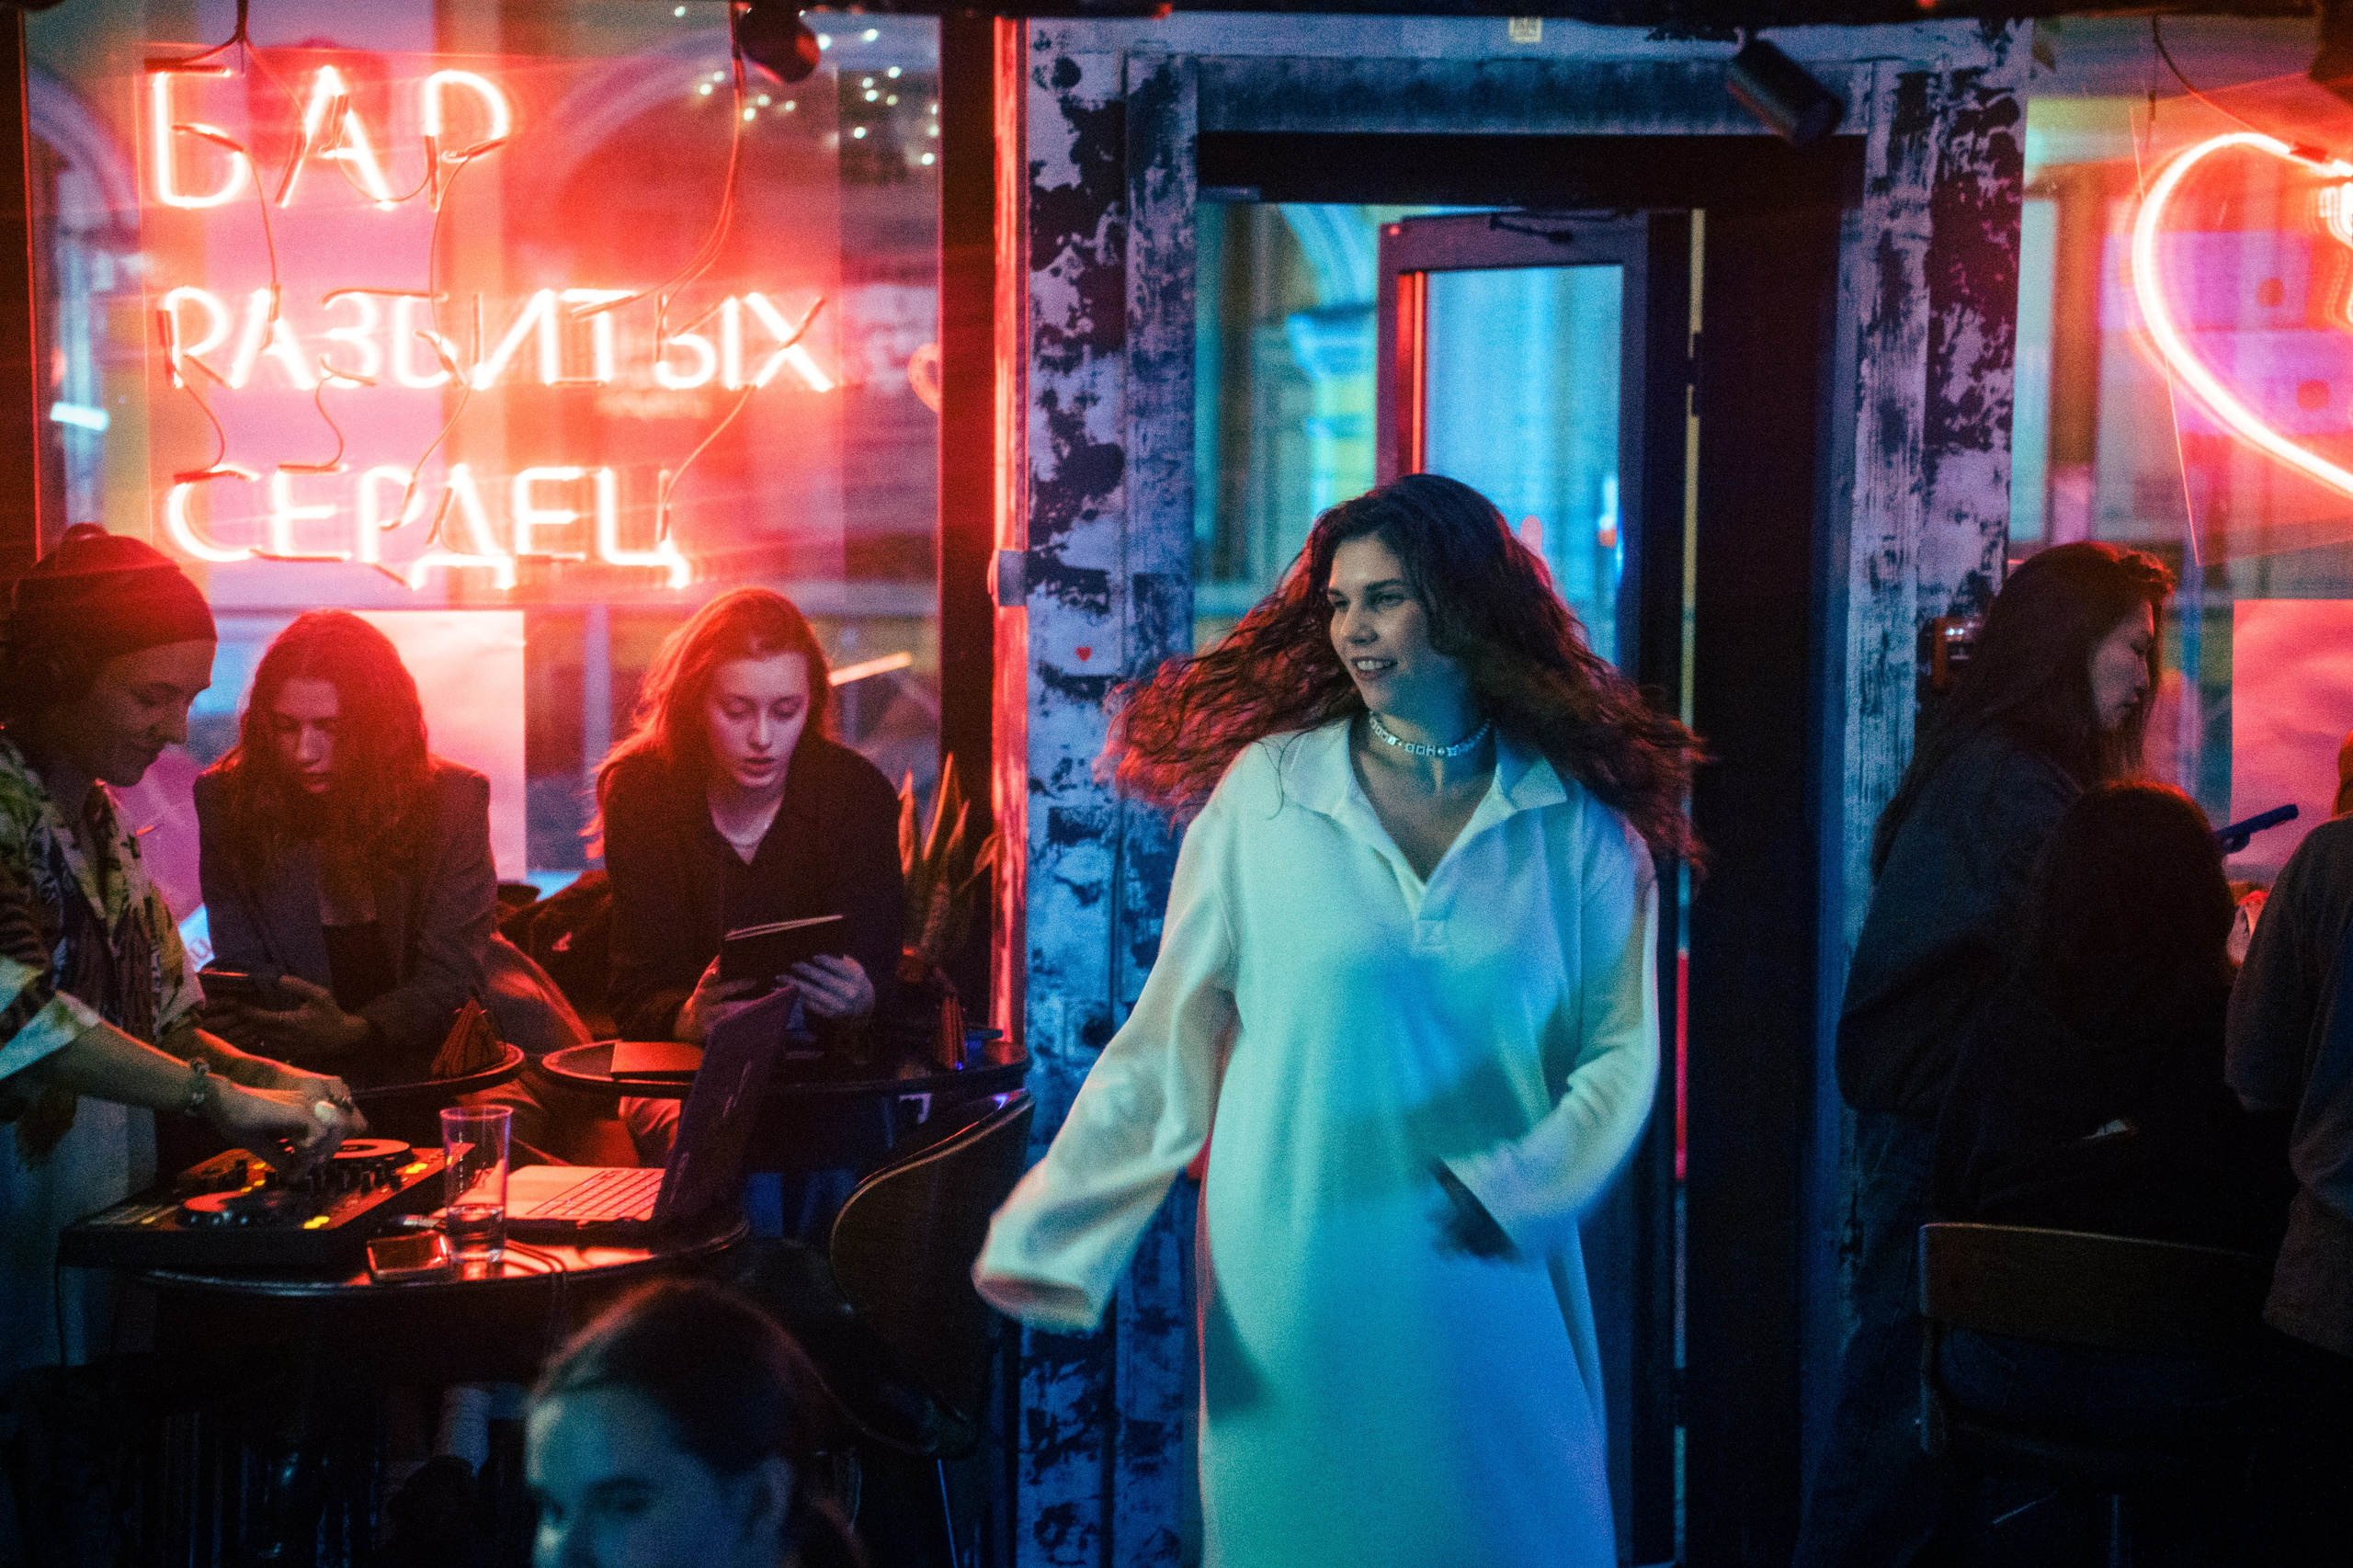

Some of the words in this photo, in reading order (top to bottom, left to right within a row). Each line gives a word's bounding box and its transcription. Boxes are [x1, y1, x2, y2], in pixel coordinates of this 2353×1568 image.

[150, 63, 512, 210] БАР
[157, 284, 832, 392] РАЗБИТЫХ
[165, 462, 692, 590] СЕРДЕЦ
